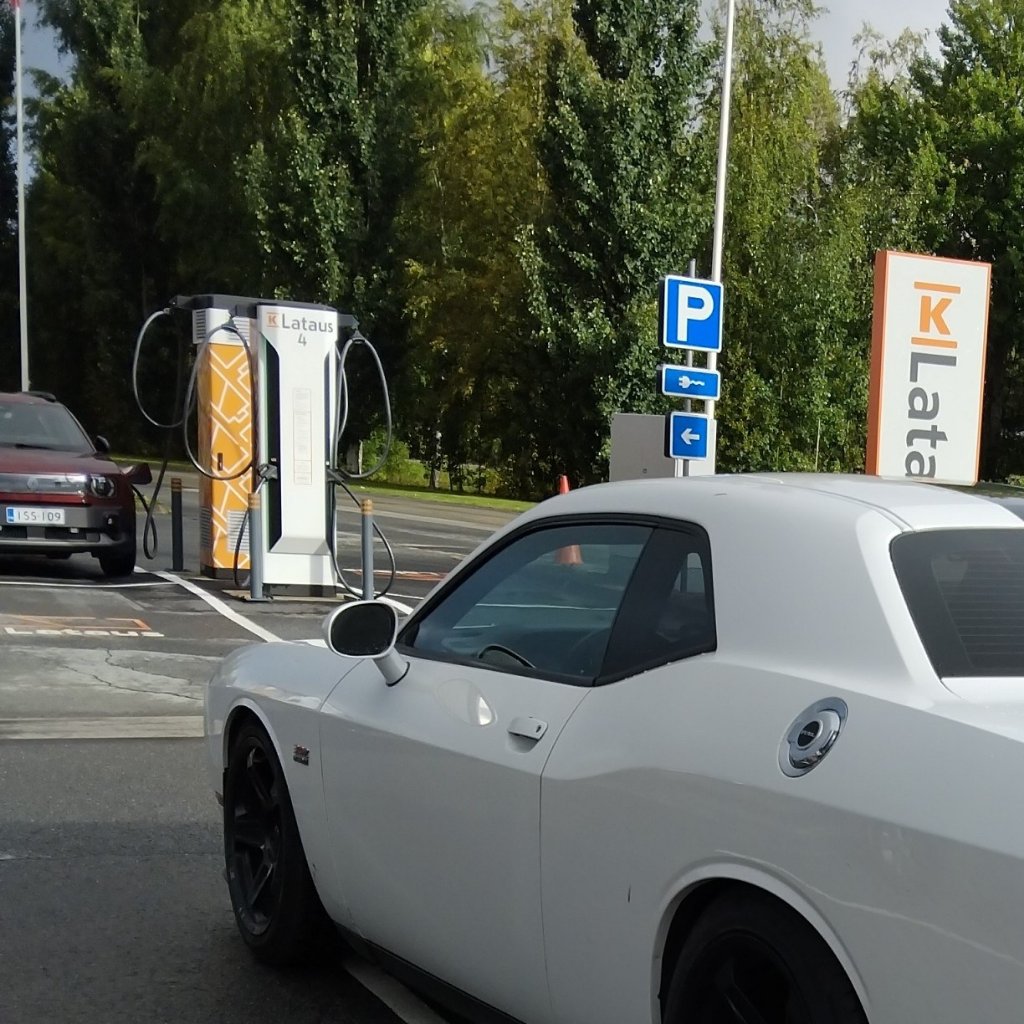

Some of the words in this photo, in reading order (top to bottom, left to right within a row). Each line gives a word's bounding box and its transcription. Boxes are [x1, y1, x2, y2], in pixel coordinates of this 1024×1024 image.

[282, 313, 334, 333] Lataus
[677, 284, 715, 341] P
[918, 295, 953, 335] K
[298, 333, 307, 347] 4
